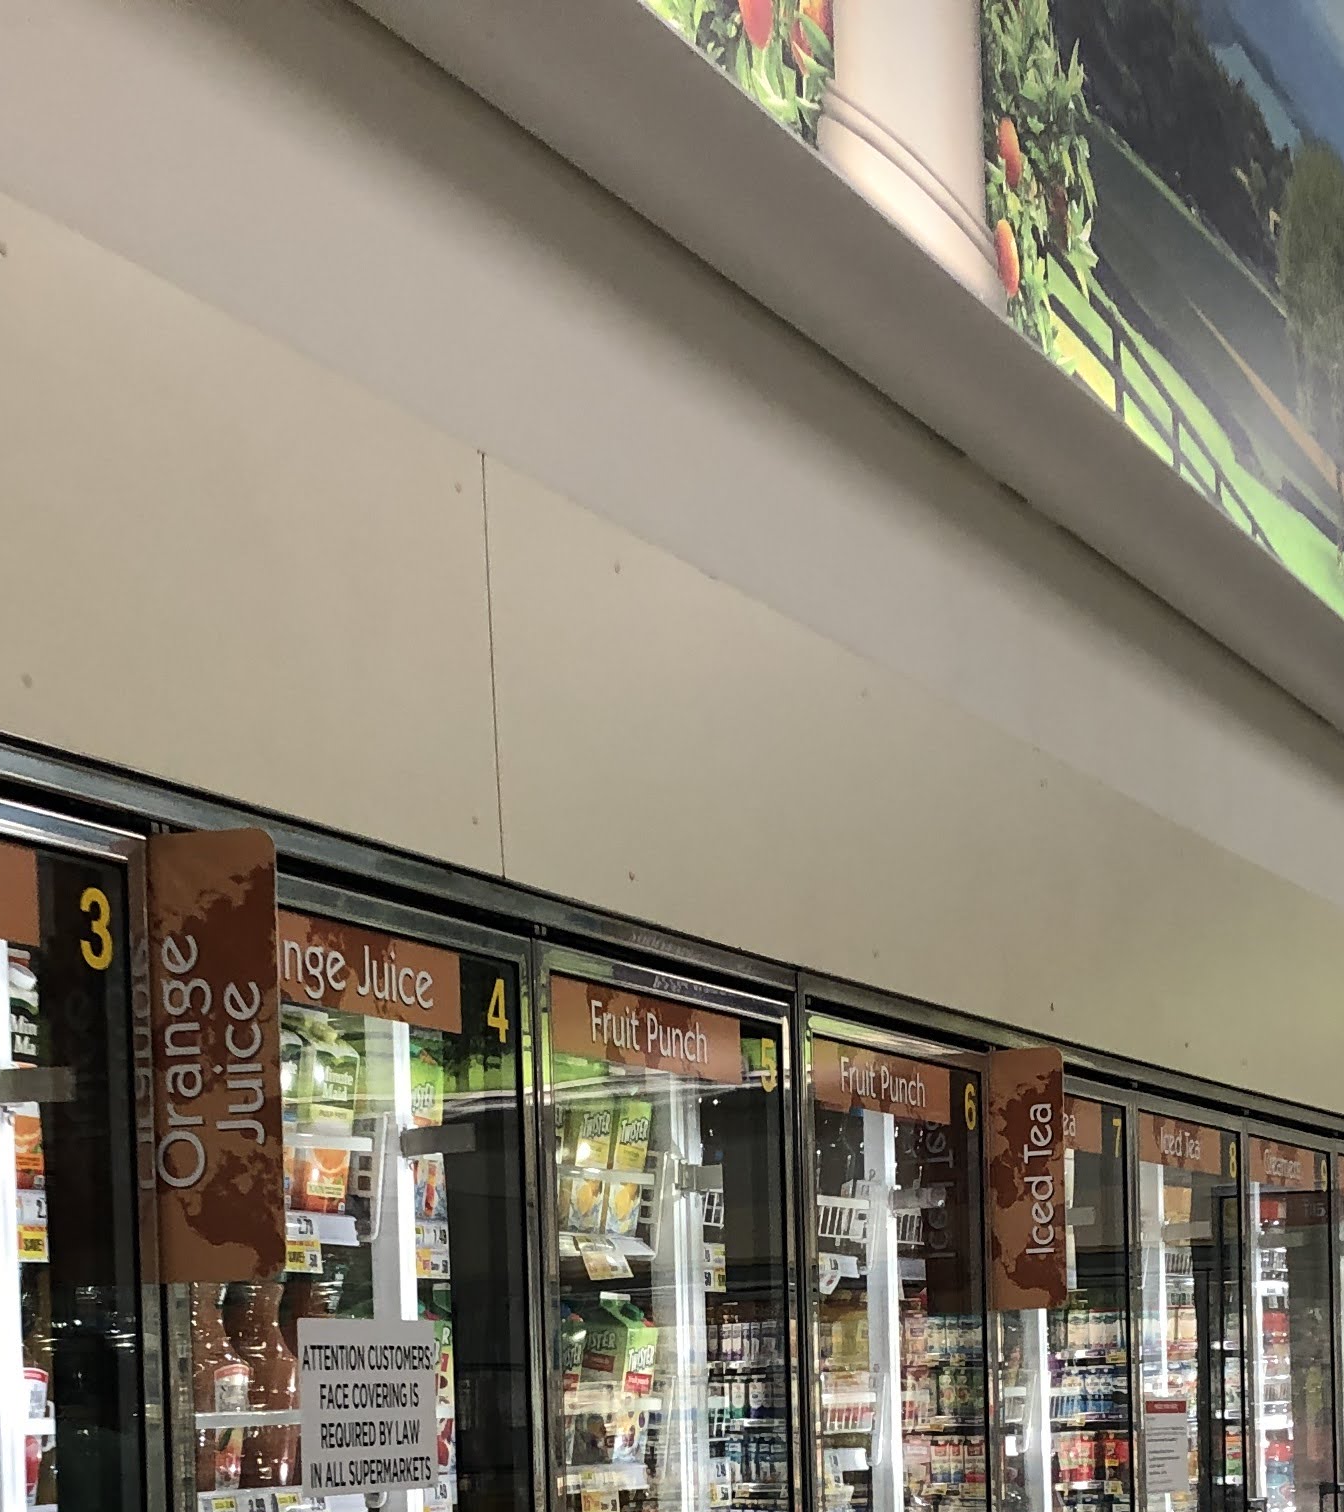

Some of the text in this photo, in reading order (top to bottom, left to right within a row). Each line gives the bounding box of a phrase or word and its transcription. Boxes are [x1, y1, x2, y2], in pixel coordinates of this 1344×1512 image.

[79, 887, 113, 970] 3
[281, 939, 434, 1009] nge Juice
[487, 978, 508, 1043] 4
[591, 1000, 708, 1064] Fruit Punch
[158, 934, 212, 1188] Orange
[216, 980, 265, 1145] Juice
[761, 1038, 777, 1092] 5
[840, 1056, 926, 1107] Fruit Punch
[965, 1083, 977, 1130] 6
[619, 1117, 649, 1145] TWISTER
[1112, 1118, 1122, 1158] 7
[1160, 1126, 1201, 1160] Iced Tea
[1023, 1103, 1055, 1255] Iced Tea
[1229, 1142, 1237, 1178] 8
[1320, 1159, 1327, 1192] 9
[302, 1345, 433, 1371] ATTENTION CUSTOMERS:
[320, 1383, 419, 1409] FACE COVERING IS
[321, 1420, 420, 1448] REQUIRED BY LAW
[311, 1456, 431, 1488] IN ALL SUPERMARKETS
